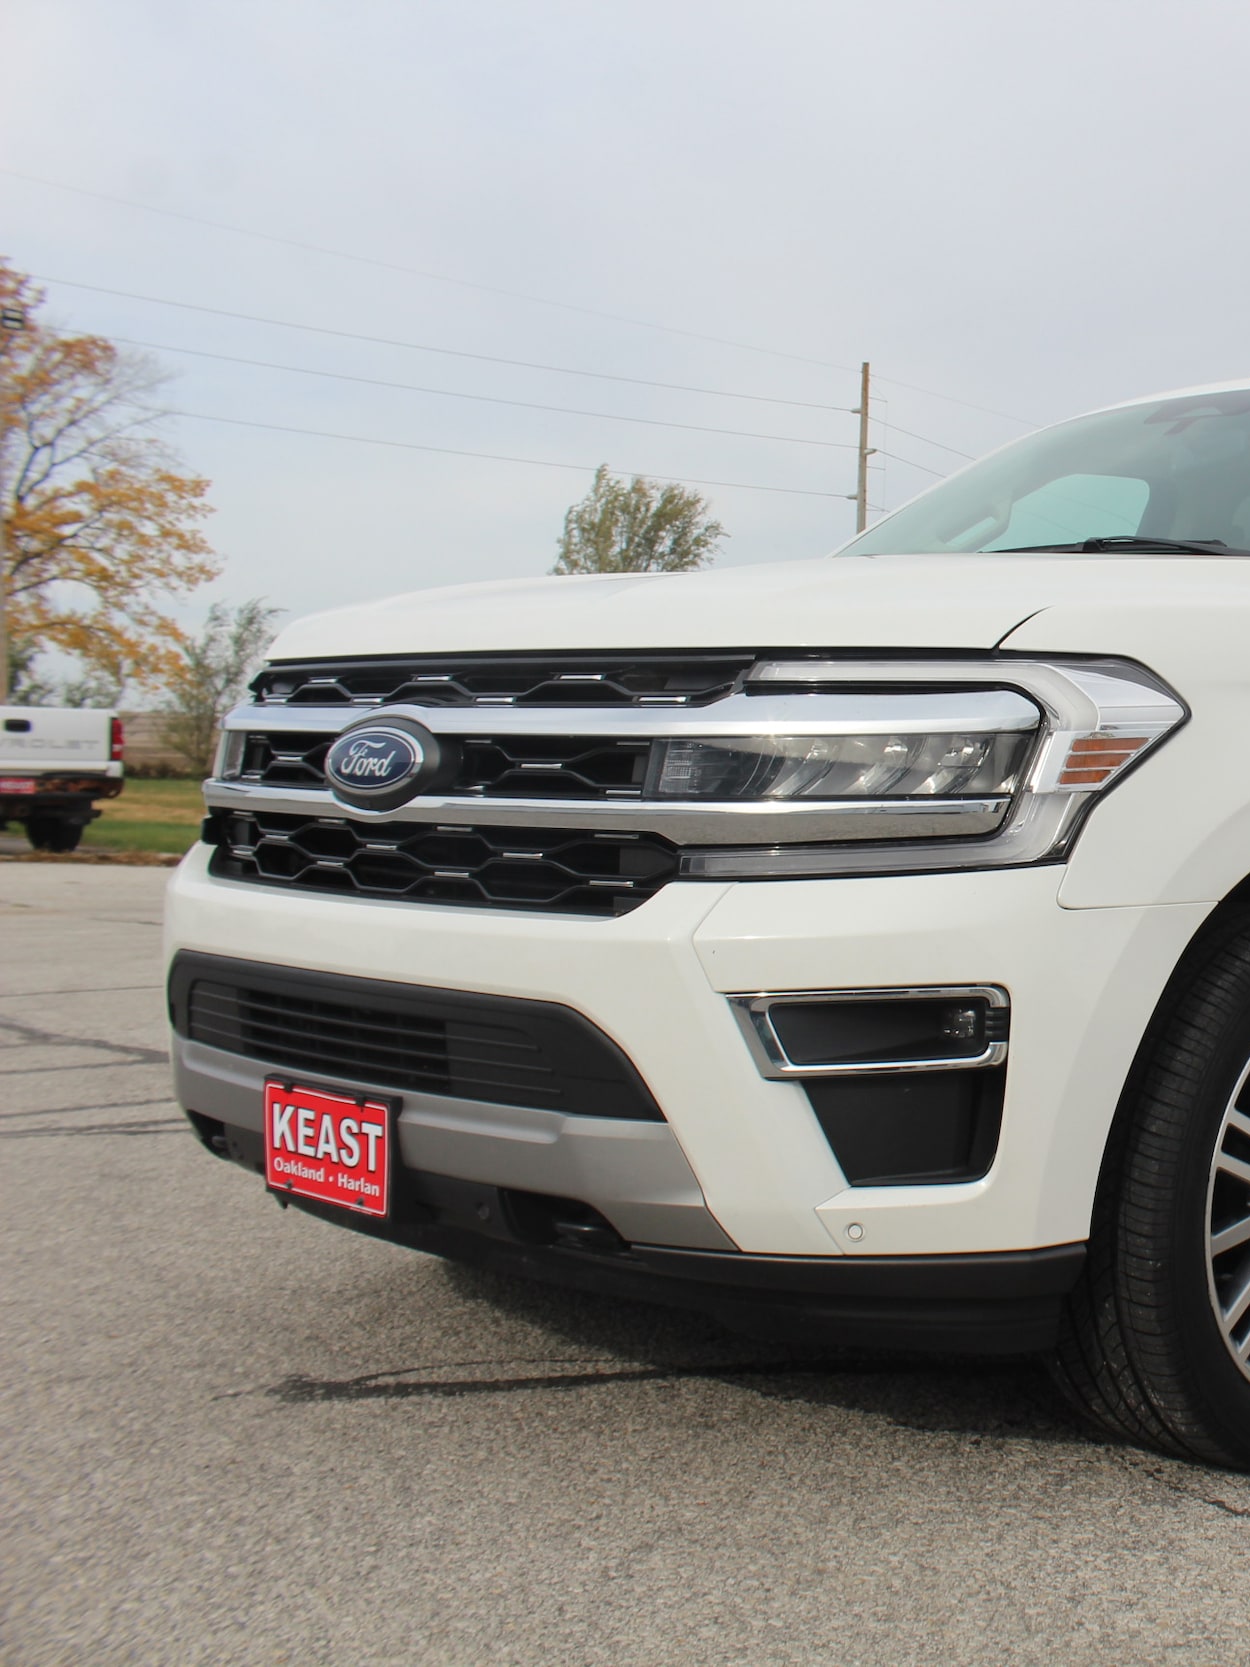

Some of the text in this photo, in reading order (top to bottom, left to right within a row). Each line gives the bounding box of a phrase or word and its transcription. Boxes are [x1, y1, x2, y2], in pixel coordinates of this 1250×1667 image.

[341, 740, 396, 777] Ford
[272, 1103, 383, 1171] KEAST
[273, 1157, 380, 1197] Oakland Harlan
